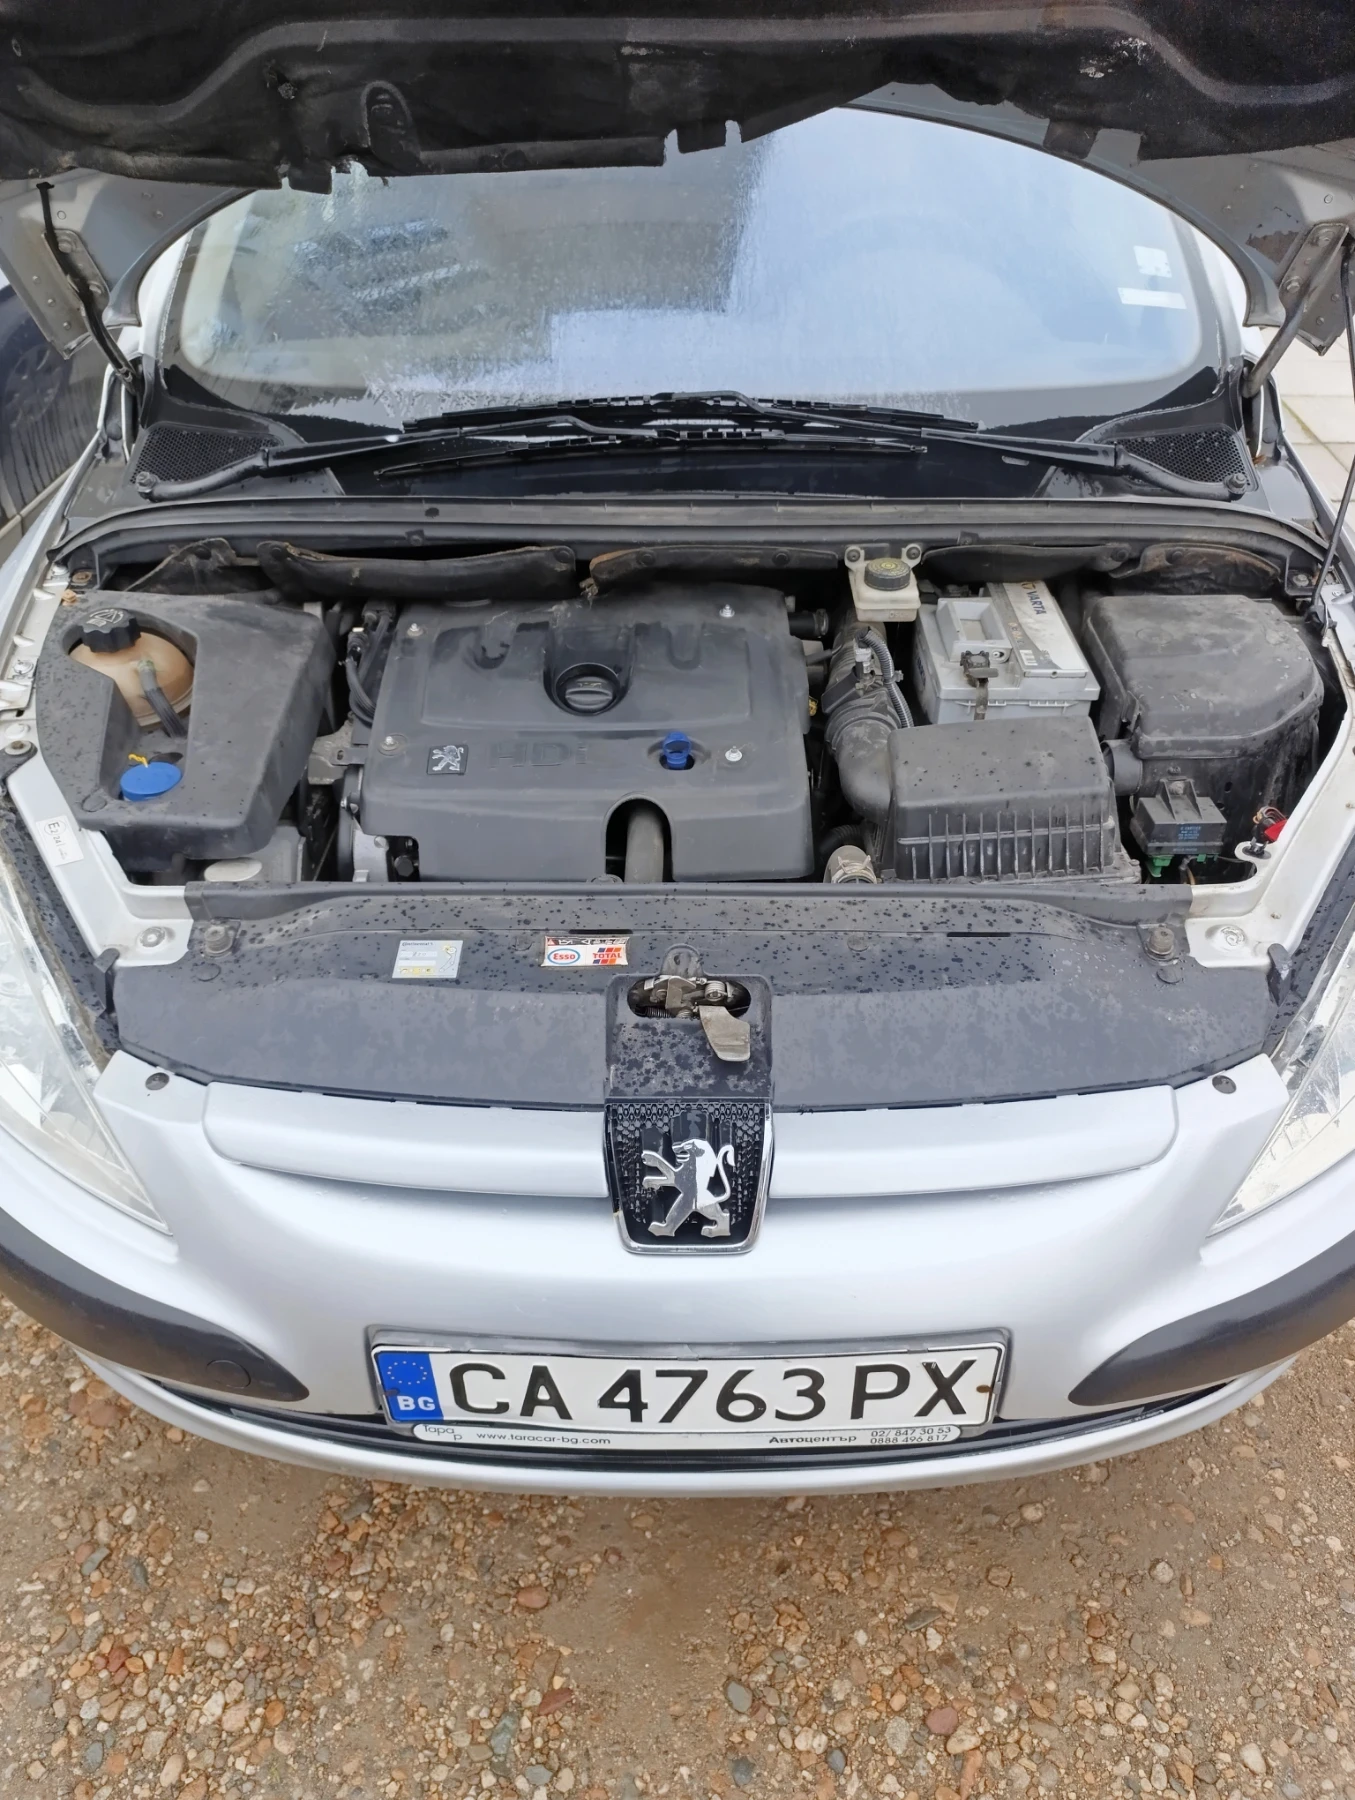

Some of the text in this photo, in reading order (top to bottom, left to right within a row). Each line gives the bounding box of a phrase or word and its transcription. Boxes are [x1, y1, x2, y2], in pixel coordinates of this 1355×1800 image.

[1027, 591, 1047, 615] VARTA
[552, 952, 577, 960] Esso
[449, 1359, 978, 1423] CA 4763 PX
[397, 1396, 436, 1411] BG
[871, 1426, 951, 1437] 02/ 847 30 53
[476, 1432, 611, 1445] www.taracar-bg.com
[768, 1435, 857, 1444] Автоцентър
[870, 1434, 948, 1445] 0888 496 817
